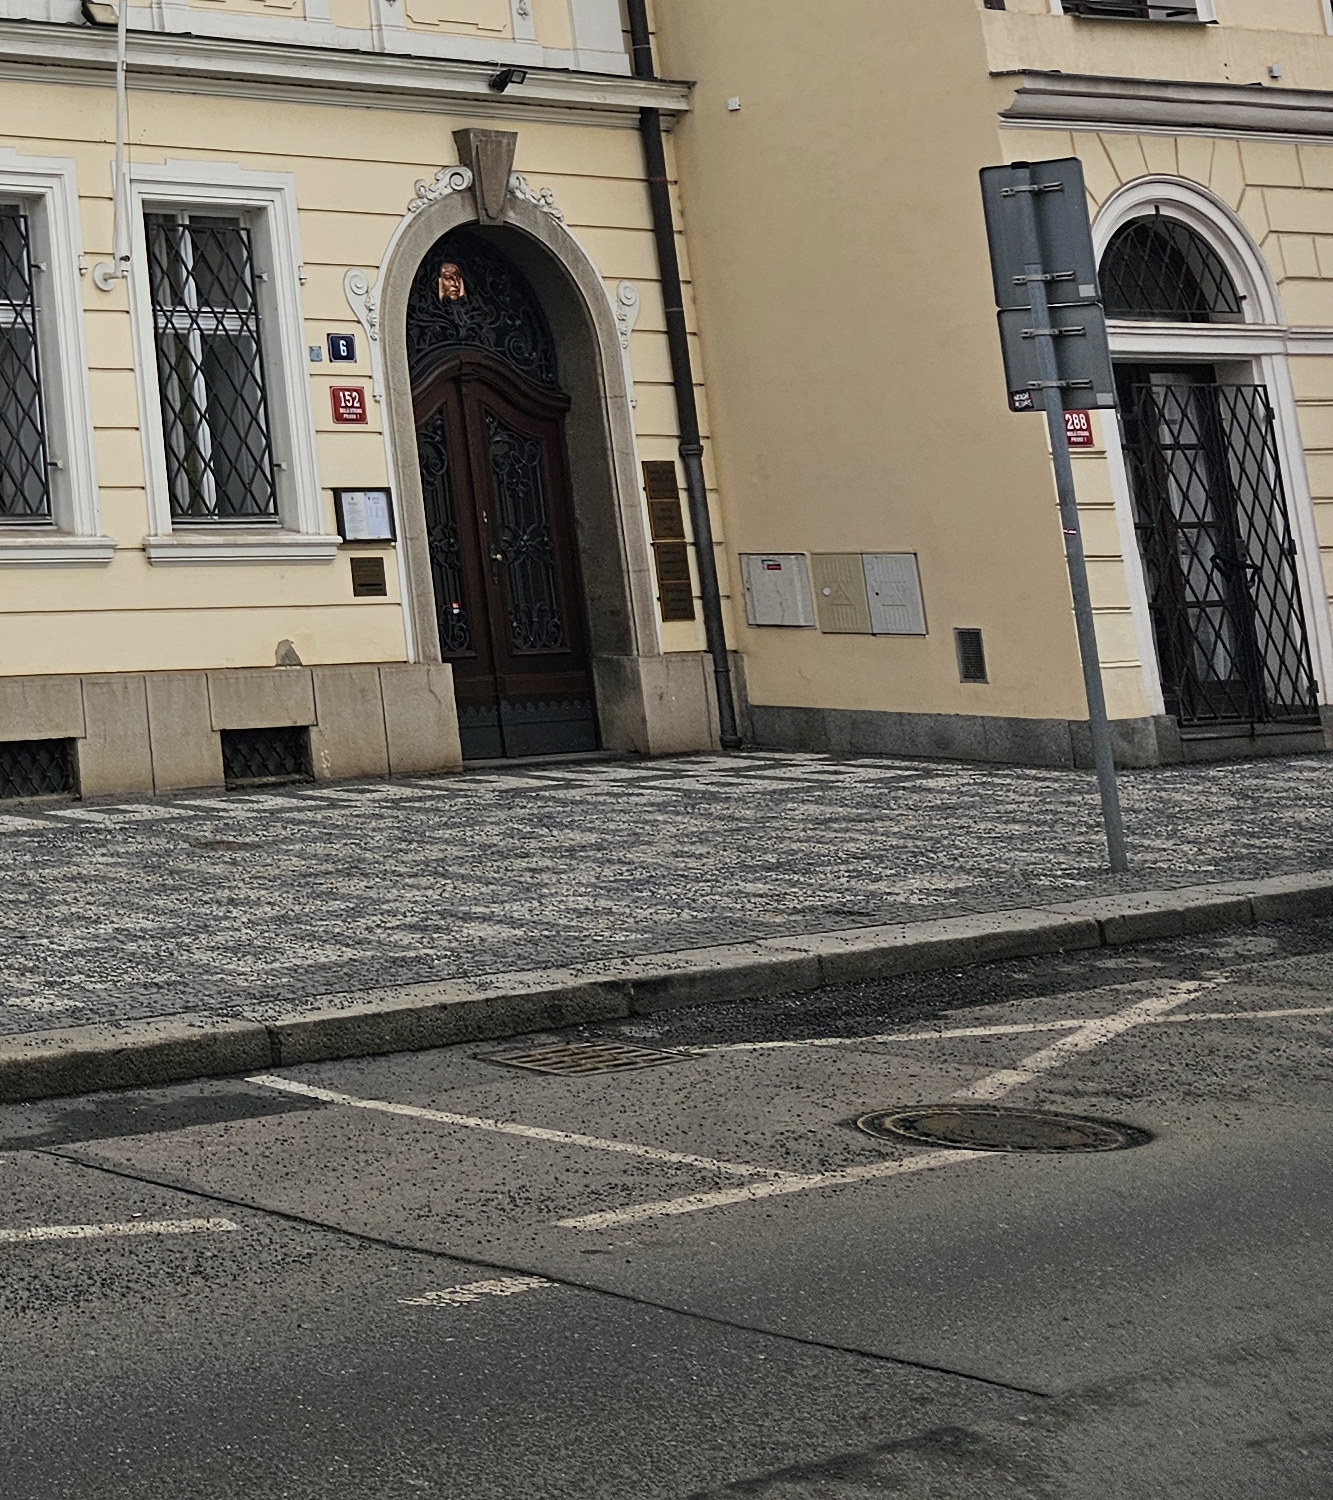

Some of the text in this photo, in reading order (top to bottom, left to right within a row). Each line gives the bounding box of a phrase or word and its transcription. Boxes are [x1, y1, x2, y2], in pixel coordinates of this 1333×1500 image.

[339, 340, 348, 357] 6
[339, 391, 361, 407] 152
[1065, 413, 1088, 430] 288
